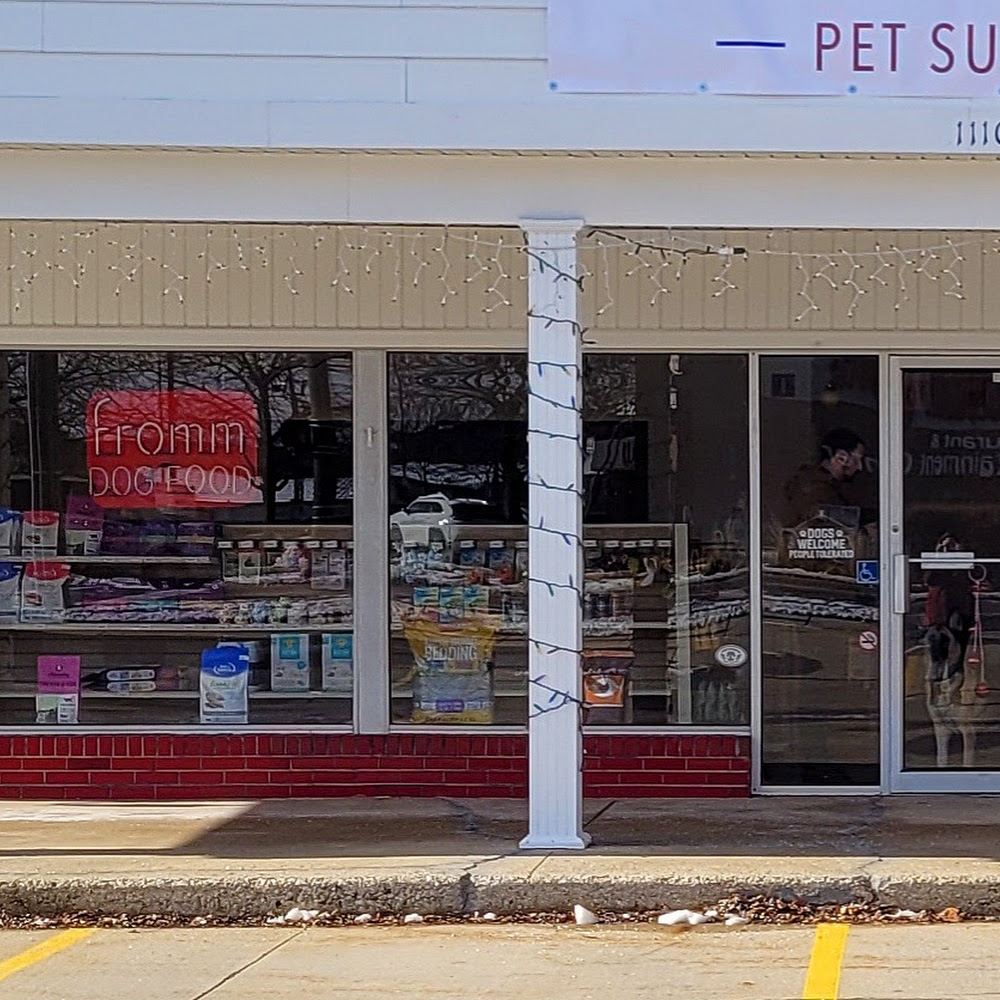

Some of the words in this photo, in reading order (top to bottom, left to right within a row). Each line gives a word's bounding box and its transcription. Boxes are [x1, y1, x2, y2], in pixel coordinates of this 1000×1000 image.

[816, 22, 907, 72] PET
[89, 466, 154, 497] DOG
[166, 464, 251, 495] FOOD
[797, 539, 846, 549] WELCOME
[807, 528, 835, 539] DOGS
